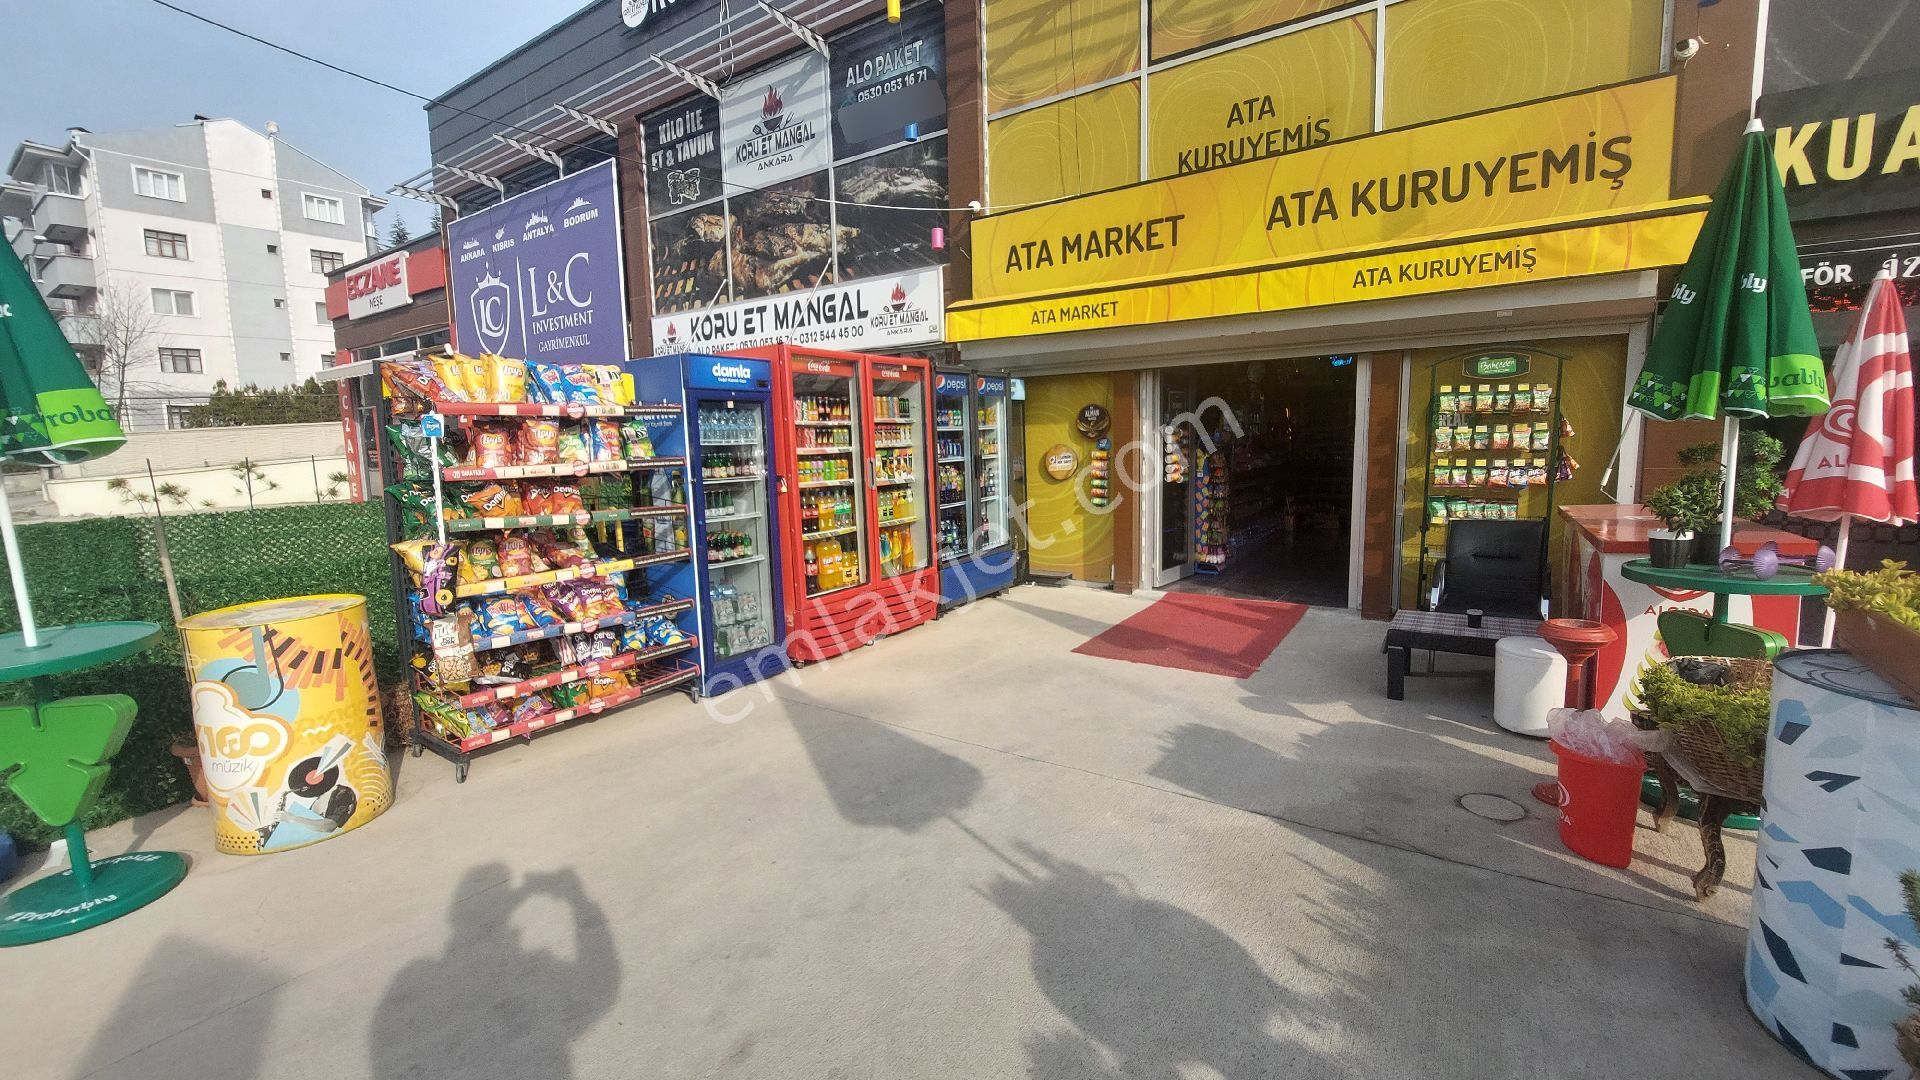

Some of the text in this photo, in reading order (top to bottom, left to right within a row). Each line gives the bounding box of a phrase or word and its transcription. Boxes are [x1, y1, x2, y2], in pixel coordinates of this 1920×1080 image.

[845, 40, 923, 88] ALO PAKET
[857, 71, 927, 103] 0530 053 16 71
[1227, 95, 1276, 128] ATA
[659, 108, 704, 145] KİLO İLE
[651, 131, 714, 172] ET & TAVUK
[736, 121, 816, 164] KORU ET MANGAL
[757, 153, 793, 171] ANKARA
[1265, 131, 1632, 231] ATA KURUYEMİŞ
[563, 208, 598, 228] BODRUM
[523, 224, 554, 242] ANTALYA
[1005, 214, 1185, 274] ATA MARKET
[460, 248, 485, 263] ANKARA
[492, 238, 515, 253] KIBRIS
[1352, 244, 1537, 288] ATA KURUYEMİŞ
[347, 258, 401, 300] ECZANE
[527, 253, 592, 317] L&C
[369, 294, 384, 310] NEŞE
[1031, 301, 1119, 325] ATA MARKET
[532, 310, 593, 335] INVESTMENT
[690, 289, 869, 343] KORU ET MANGAL
[871, 310, 929, 328] KORU ET MANGAL
[538, 334, 590, 352] GAYRİMENKUL
[800, 331, 818, 344] 0312
[820, 329, 836, 342] 544
[838, 327, 849, 339] 45
[852, 325, 864, 337] 00
[886, 328, 912, 336] ANKARA
[712, 363, 751, 379] damla
[946, 378, 967, 391] pepsi
[986, 381, 1004, 393] pepsi
[211, 757, 255, 775] müzik
